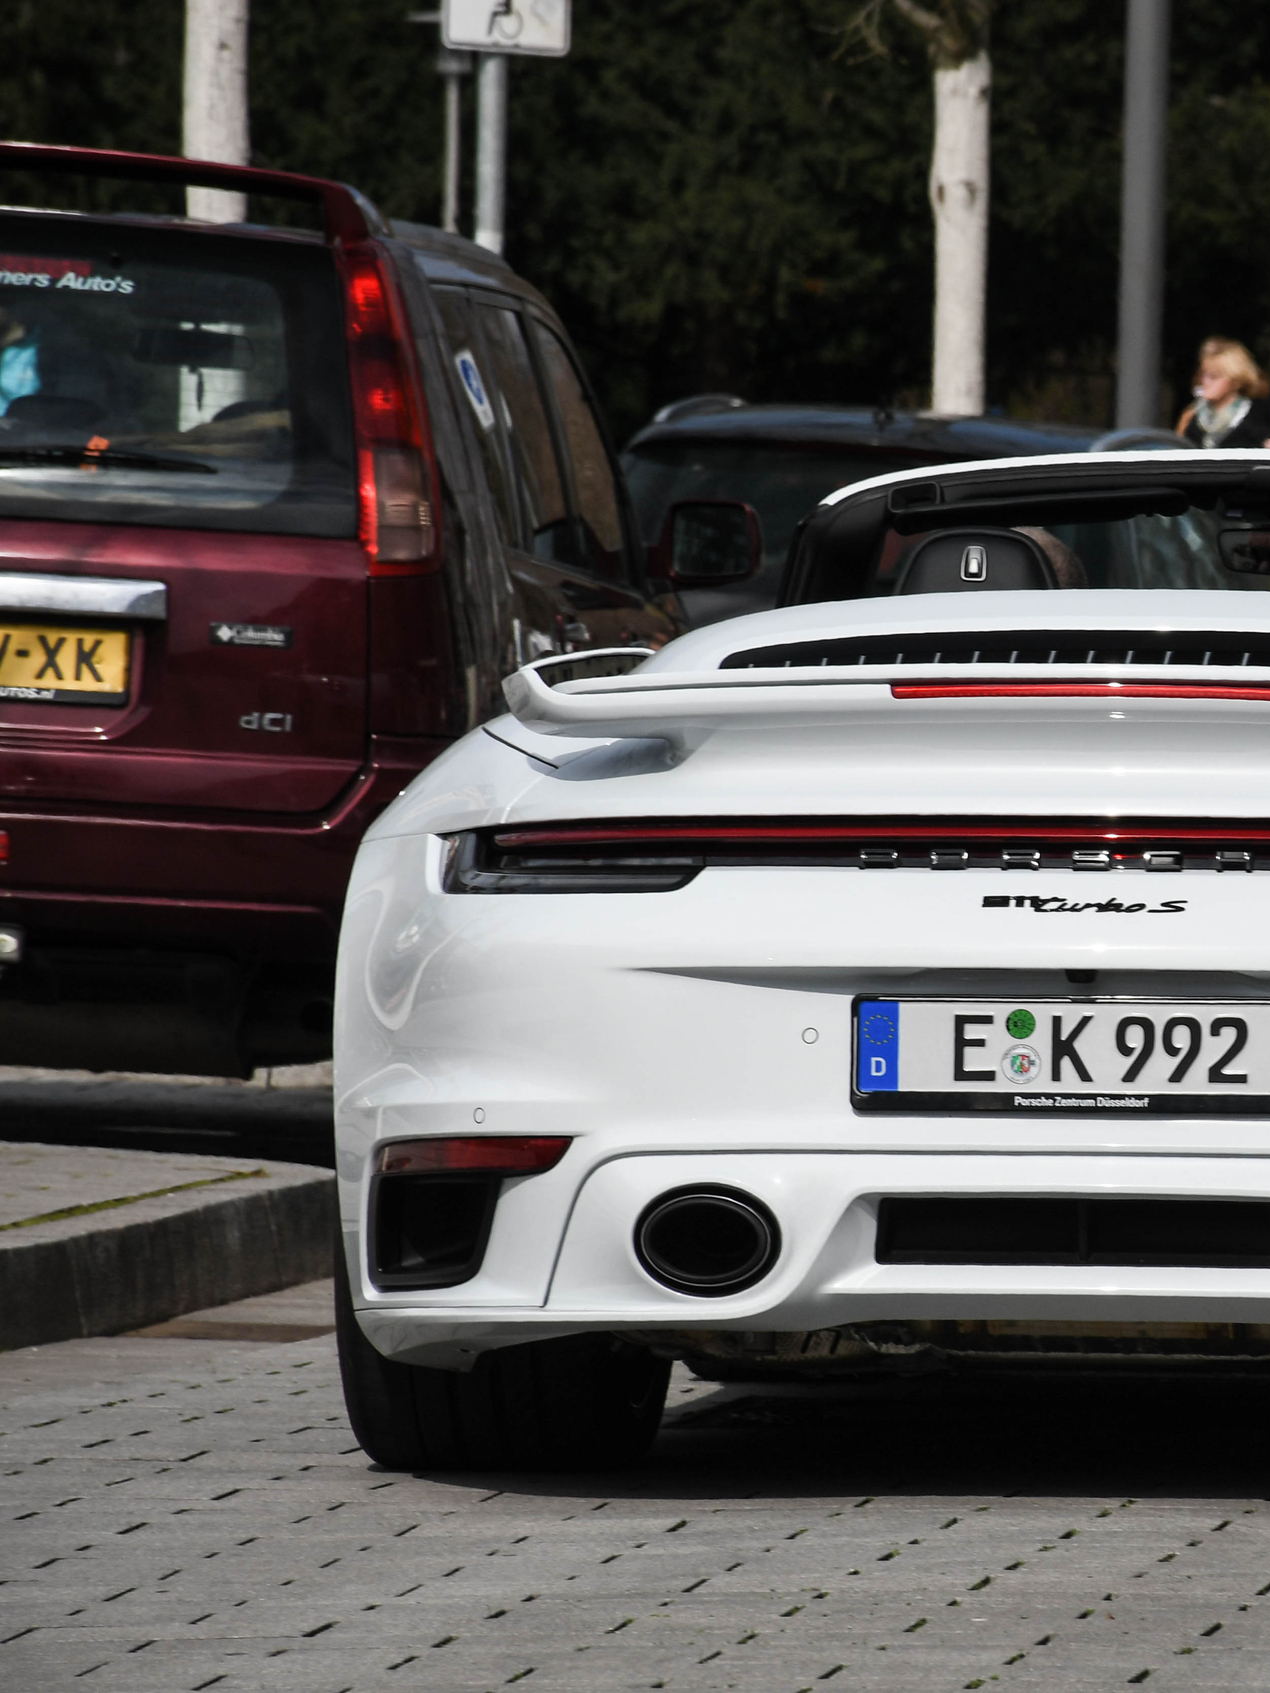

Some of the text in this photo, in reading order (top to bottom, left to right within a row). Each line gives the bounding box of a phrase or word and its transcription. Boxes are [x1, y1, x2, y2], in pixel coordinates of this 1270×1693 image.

[55, 271, 136, 294] Auto's
[1147, 900, 1188, 913] S
[953, 1014, 1249, 1084] E K 992
[870, 1056, 887, 1077] D
[1013, 1096, 1150, 1108] Porsche Zentrum Düsseldorf
